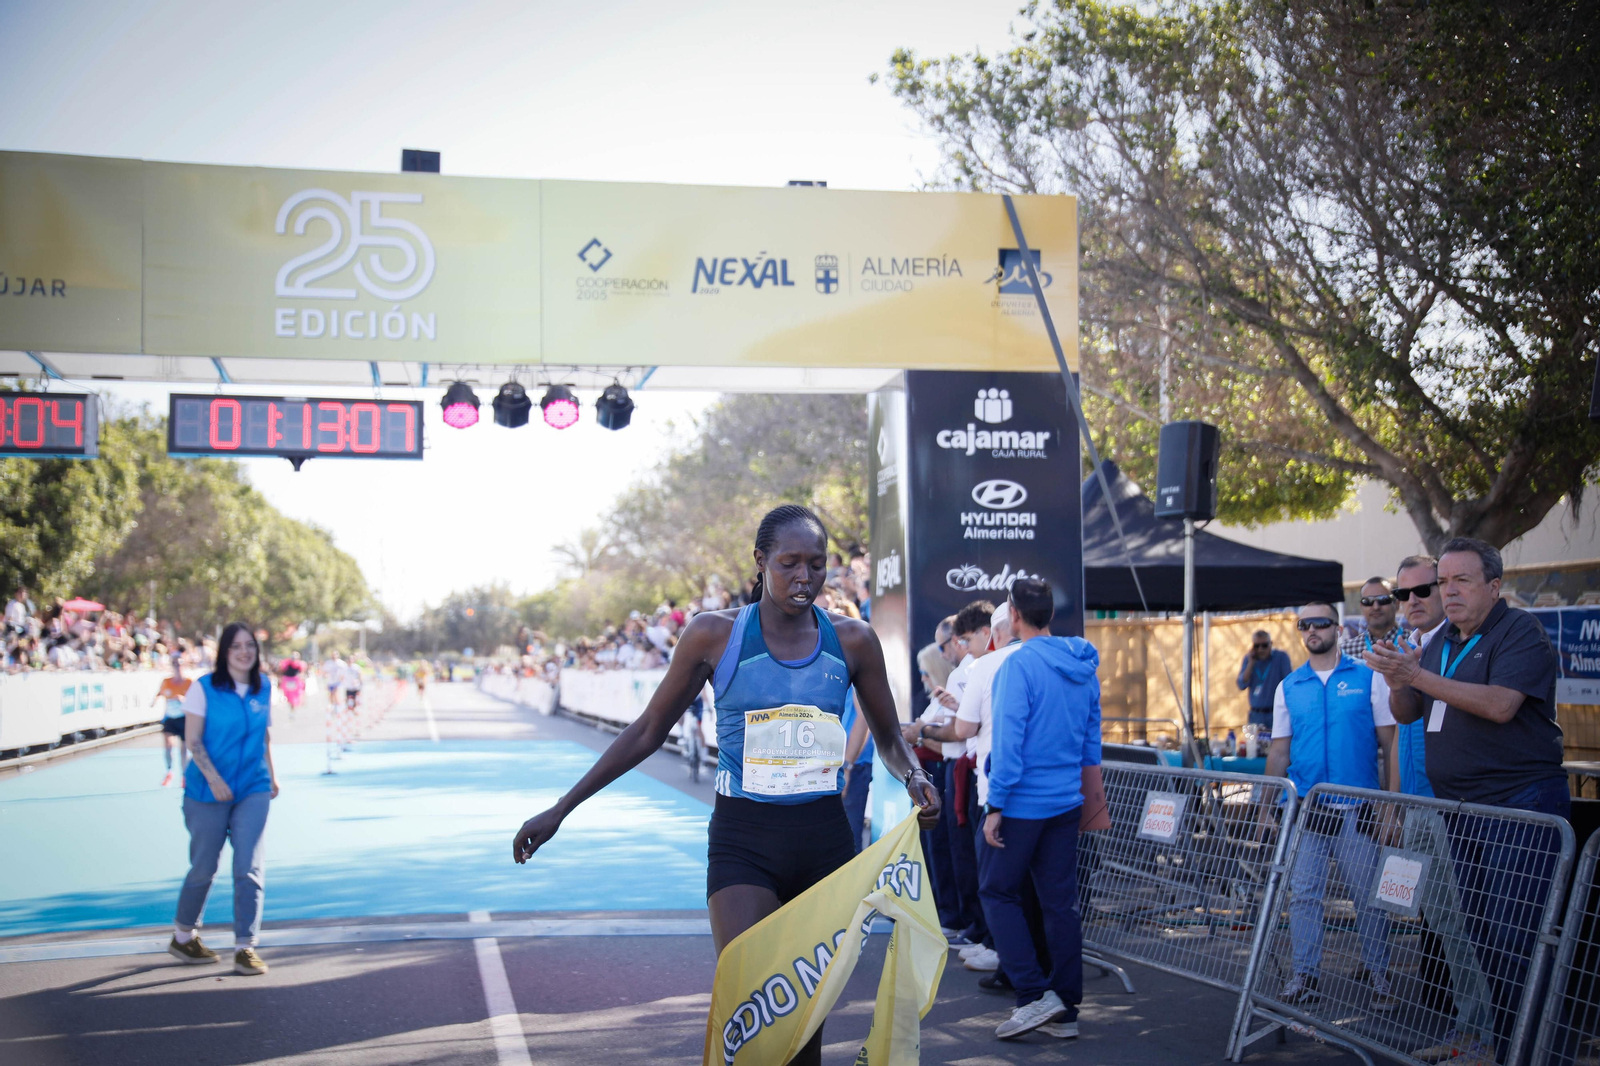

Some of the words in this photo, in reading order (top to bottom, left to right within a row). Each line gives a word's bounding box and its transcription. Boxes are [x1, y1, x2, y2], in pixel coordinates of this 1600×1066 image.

[275, 187, 436, 301] 25
[861, 253, 963, 277] ALMERÍA
[576, 276, 668, 290] COOPERACIÓN
[860, 278, 913, 292] CIUDAD
[275, 303, 436, 341] EDICIÓN
[0, 397, 84, 449] :04
[209, 398, 415, 454] 01:13:07
[936, 423, 1051, 456] cajamar
[991, 449, 1016, 459] CAJA
[1017, 449, 1048, 459] RURAL
[960, 512, 1037, 526] HYUNDAI
[963, 526, 1035, 540] Almerialva
[779, 720, 816, 748] 16
[752, 747, 788, 756] CAROLYNE
[1145, 818, 1174, 833] EVENTOS
[1380, 880, 1414, 901] EVENTOS
